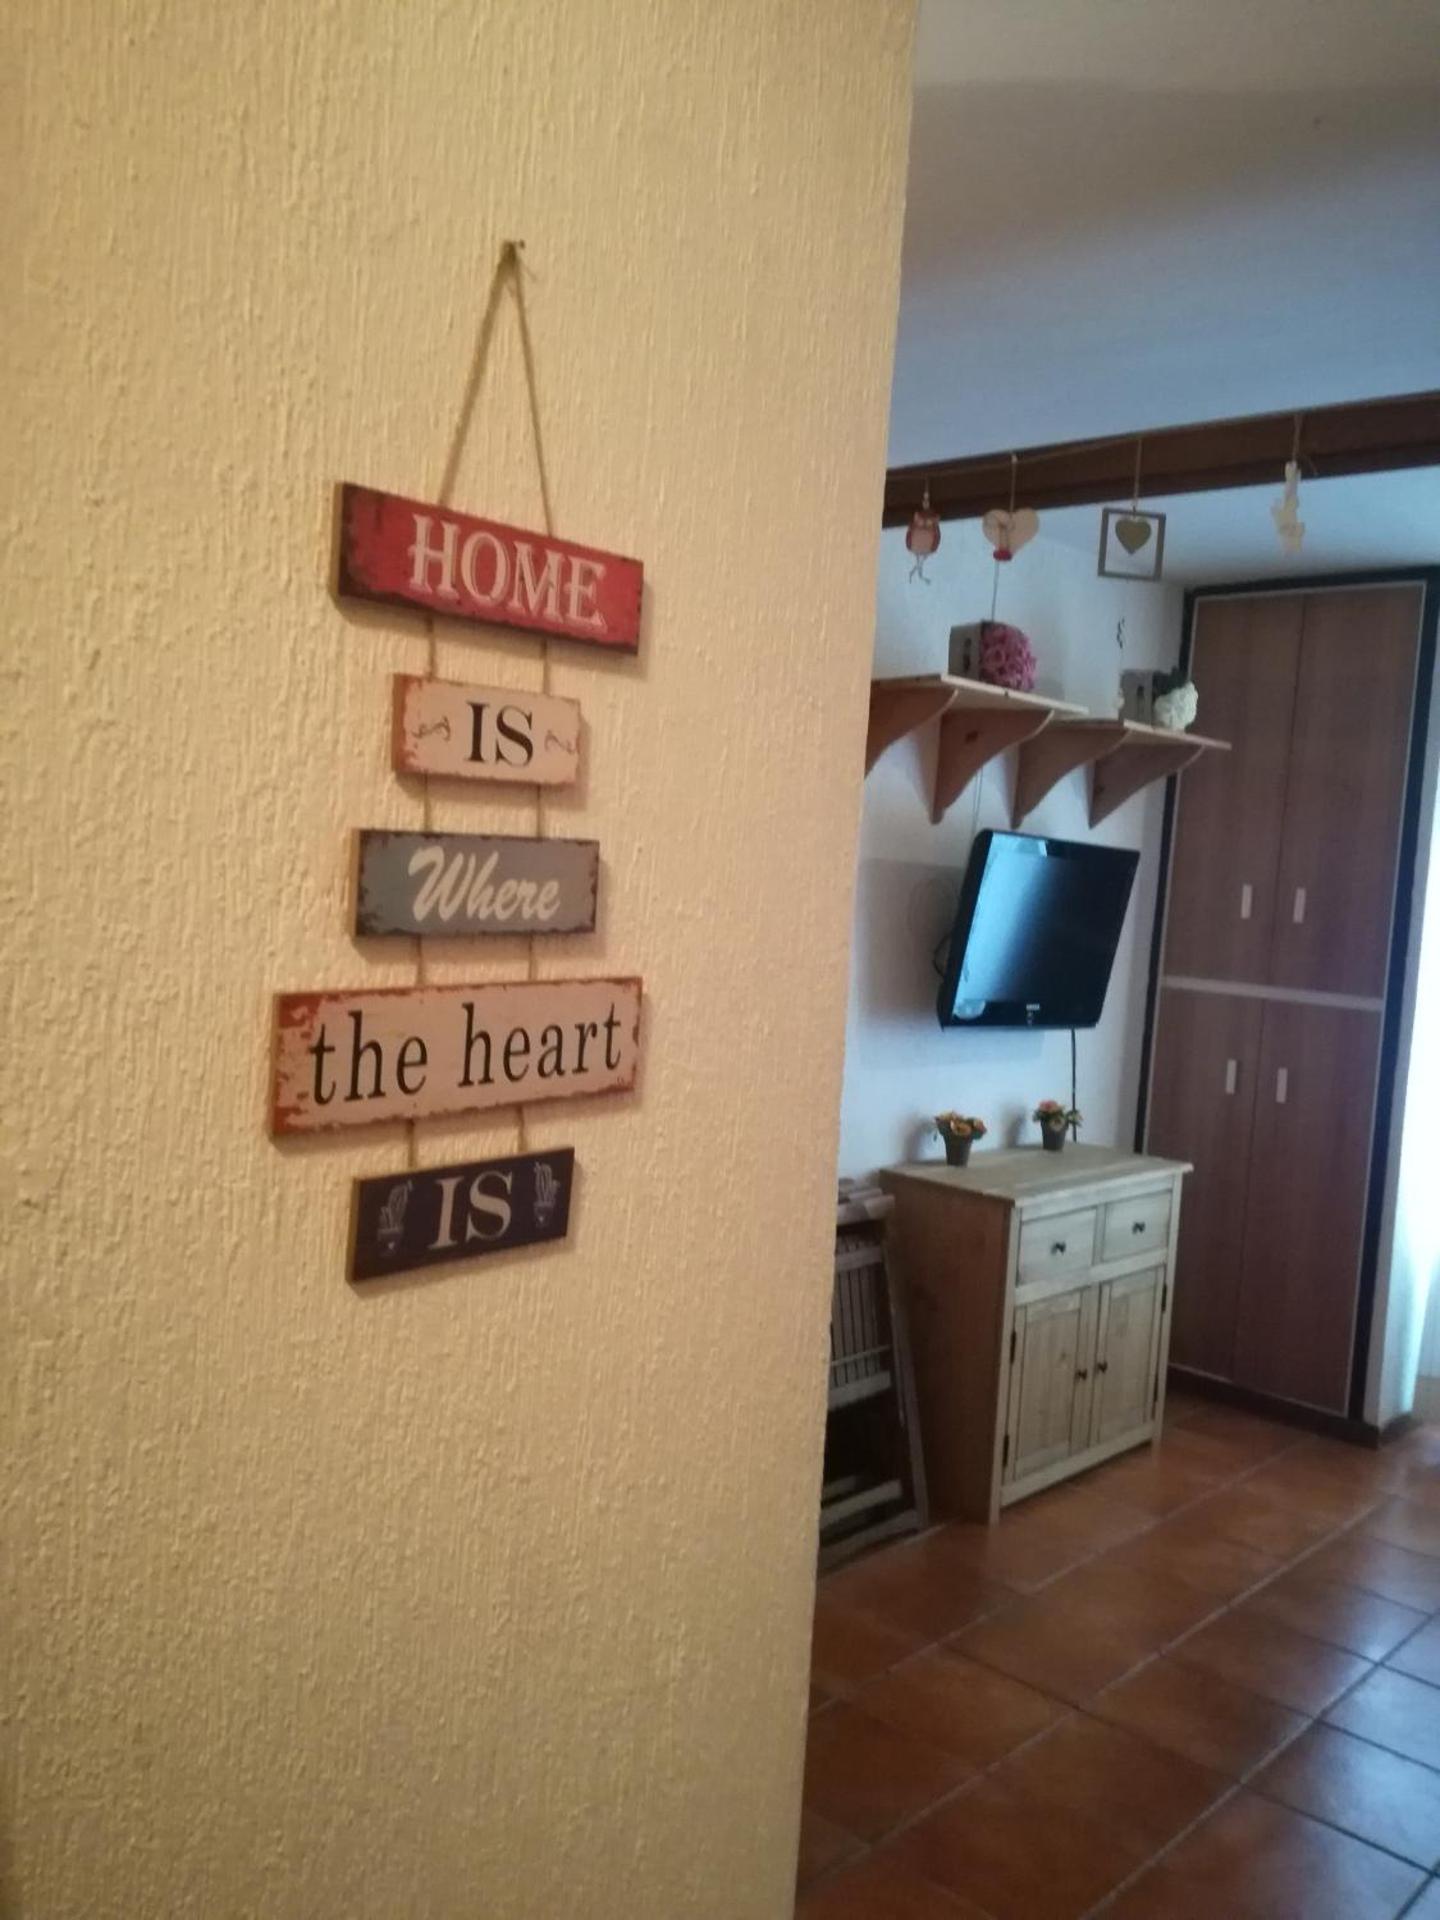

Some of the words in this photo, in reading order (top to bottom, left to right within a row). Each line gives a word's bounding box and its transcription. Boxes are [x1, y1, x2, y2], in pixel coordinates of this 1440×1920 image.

[407, 513, 607, 634] HOME
[464, 702, 534, 767] IS
[408, 845, 561, 922] Where
[308, 1010, 428, 1106] the
[457, 1002, 621, 1088] heart
[427, 1170, 513, 1250] IS
